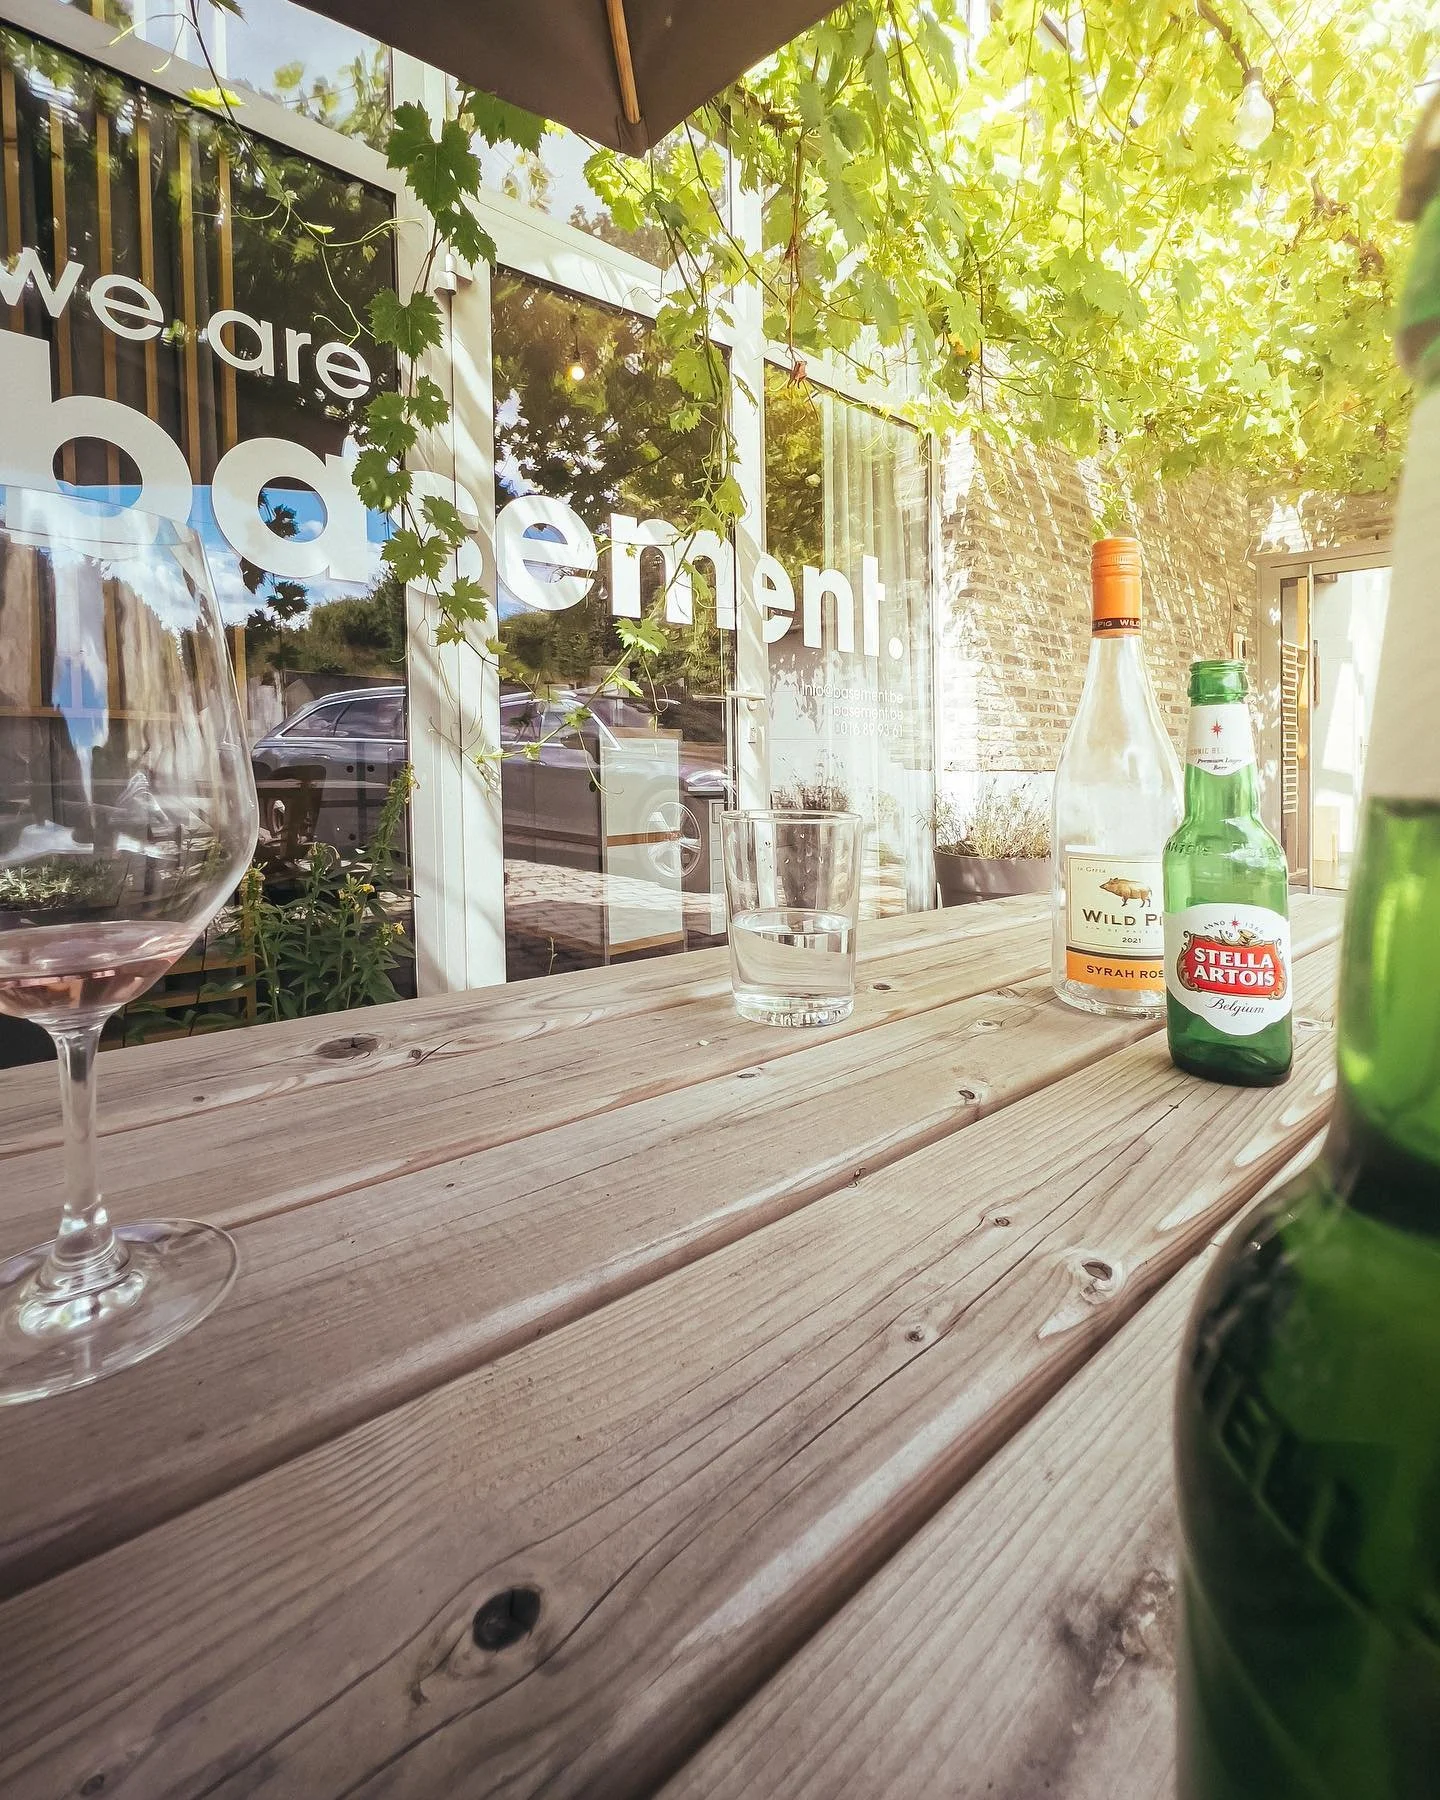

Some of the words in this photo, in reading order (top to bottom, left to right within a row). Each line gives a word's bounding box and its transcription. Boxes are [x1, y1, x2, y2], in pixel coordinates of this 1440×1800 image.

[0, 246, 165, 341] we
[206, 309, 372, 400] are
[840, 721, 860, 736] 016
[863, 721, 875, 737] 89
[877, 722, 890, 738] 93
[1144, 913, 1163, 927] PI
[1202, 920, 1227, 931] ANNO
[1122, 936, 1142, 944] 2021
[1193, 947, 1276, 970] STELLA
[1086, 964, 1135, 979] SYRAH
[1193, 965, 1277, 988] ARTOIS
[1204, 997, 1266, 1017] Belgium
